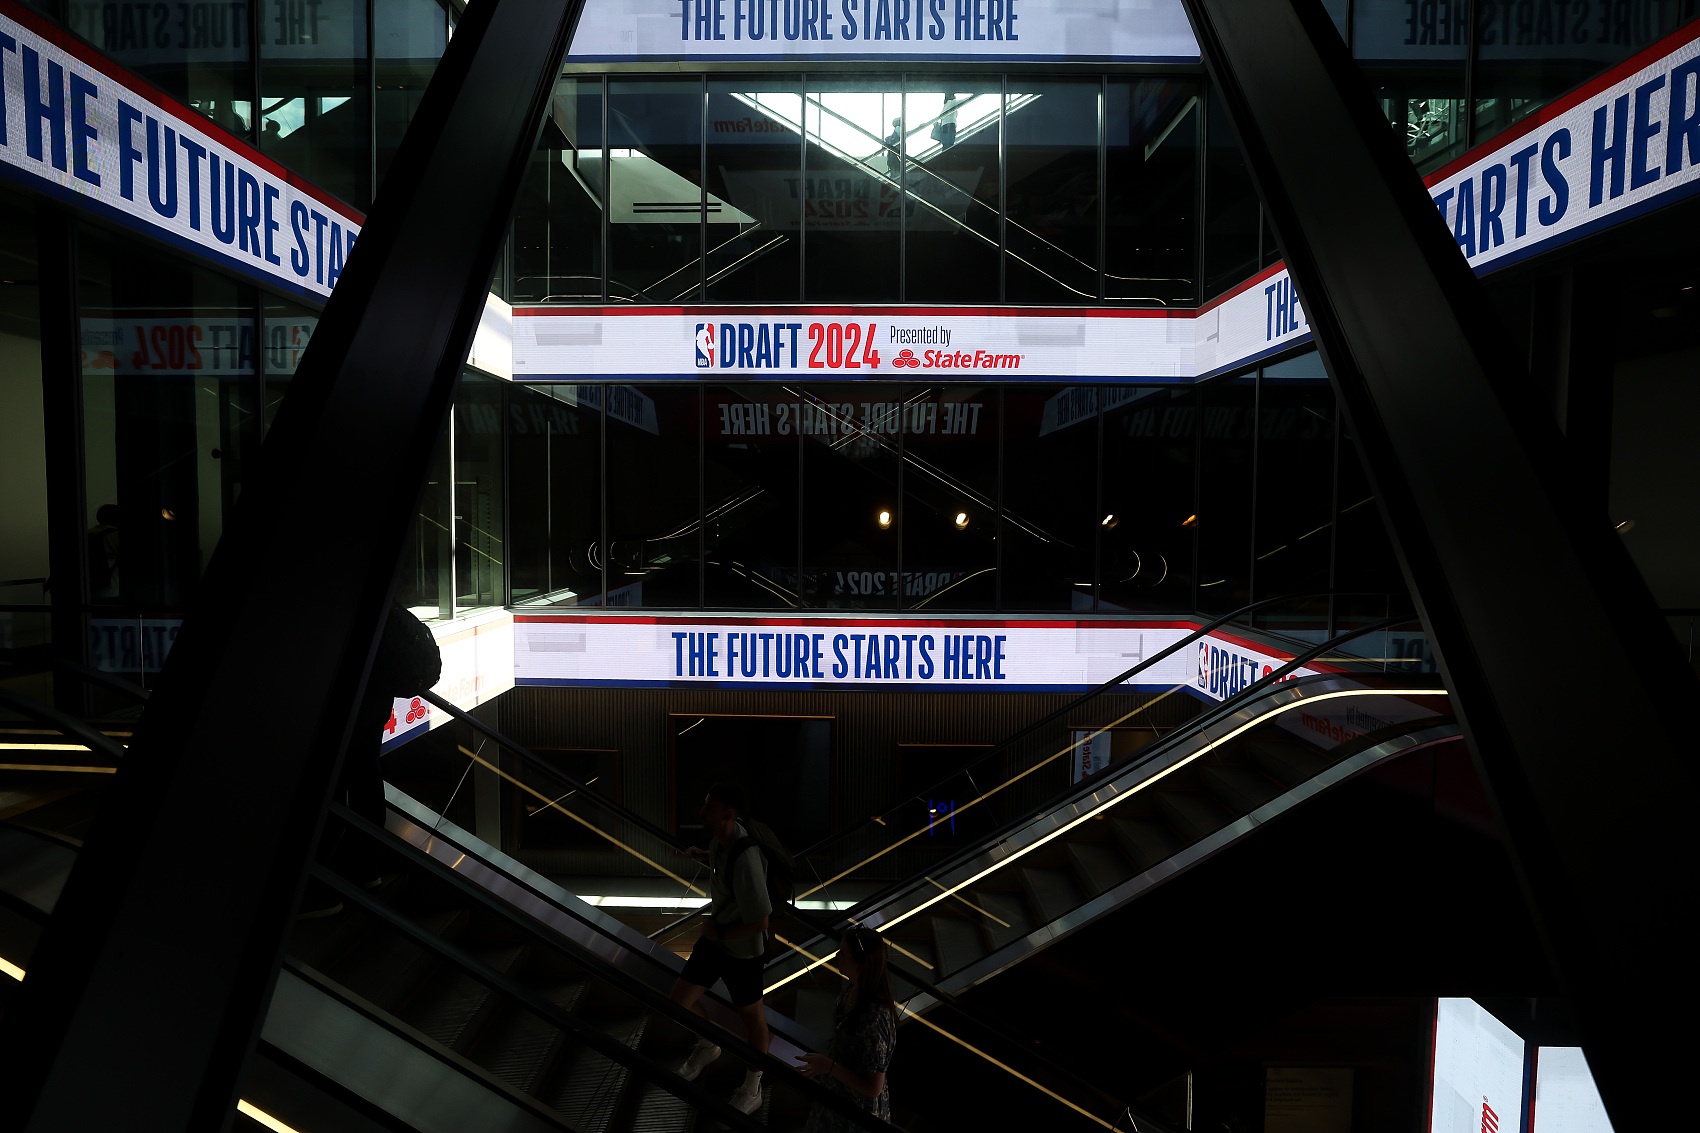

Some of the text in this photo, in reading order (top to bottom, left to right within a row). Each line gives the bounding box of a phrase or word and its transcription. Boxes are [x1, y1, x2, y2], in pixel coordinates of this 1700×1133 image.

[679, 0, 1019, 41] THE FUTURE STARTS HERE
[118, 99, 281, 267] FUTURE
[1264, 276, 1299, 341] THE
[720, 323, 802, 368] DRAFT
[808, 322, 881, 369] 2024
[890, 325, 952, 348] Presented by
[671, 632, 1007, 680] THE FUTURE STARTS HERE
[1210, 645, 1259, 701] DRAFT
